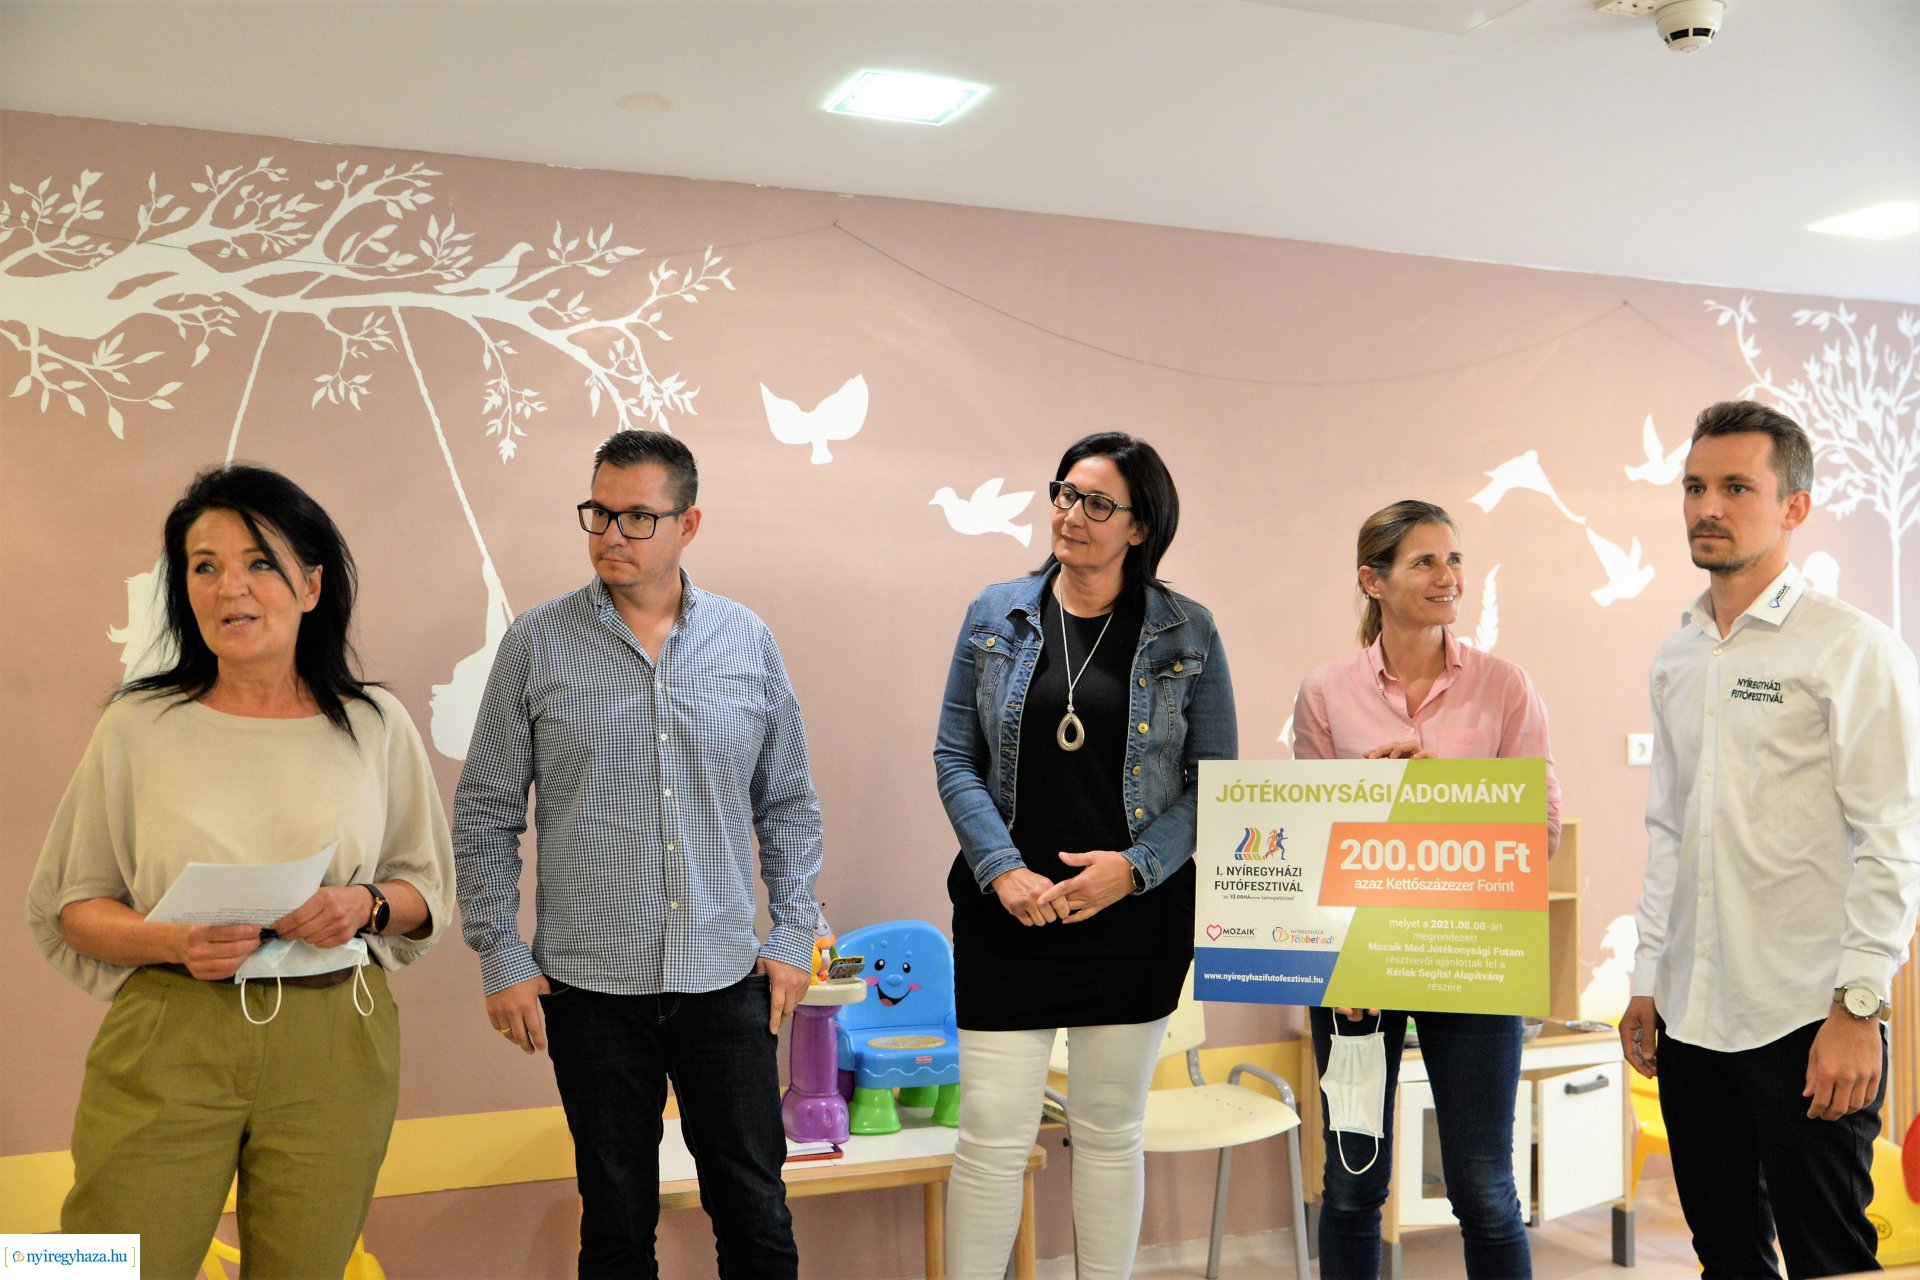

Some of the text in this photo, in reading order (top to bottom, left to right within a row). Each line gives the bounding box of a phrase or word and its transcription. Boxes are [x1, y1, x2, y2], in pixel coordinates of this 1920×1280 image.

[1736, 677, 1781, 691] NYÍREGYHÁZI
[1731, 689, 1784, 704] FUTÓFESZTIVÁL
[1215, 779, 1526, 804] JÓTÉKONYSÁGI ADOMÁNY
[1339, 838, 1531, 874] 200.000 Ft
[1216, 864, 1302, 877] I. NYÍREGYHÁZI
[1214, 879, 1304, 892] FUTÓFESZTIVÁL
[1354, 876, 1515, 893] azaz Kettőszázezer Forint
[1389, 919, 1420, 930] melyet
[1430, 920, 1503, 931] 2021.08.08-án
[1222, 928, 1255, 936] MOZAIK
[1413, 932, 1478, 943] megrendezett
[1368, 942, 1525, 958] Mozaik Med Jótékonysági Futam
[1385, 956, 1433, 966] résztvevői
[1436, 958, 1482, 969] ajánlottak
[1485, 959, 1497, 969] fel
[1203, 972, 1324, 985] www.nyiregyhazifutofesztival.hu
[1386, 967, 1416, 977] Kérlek
[1453, 970, 1505, 983] Alapítvány
[1427, 982, 1462, 992] részére
